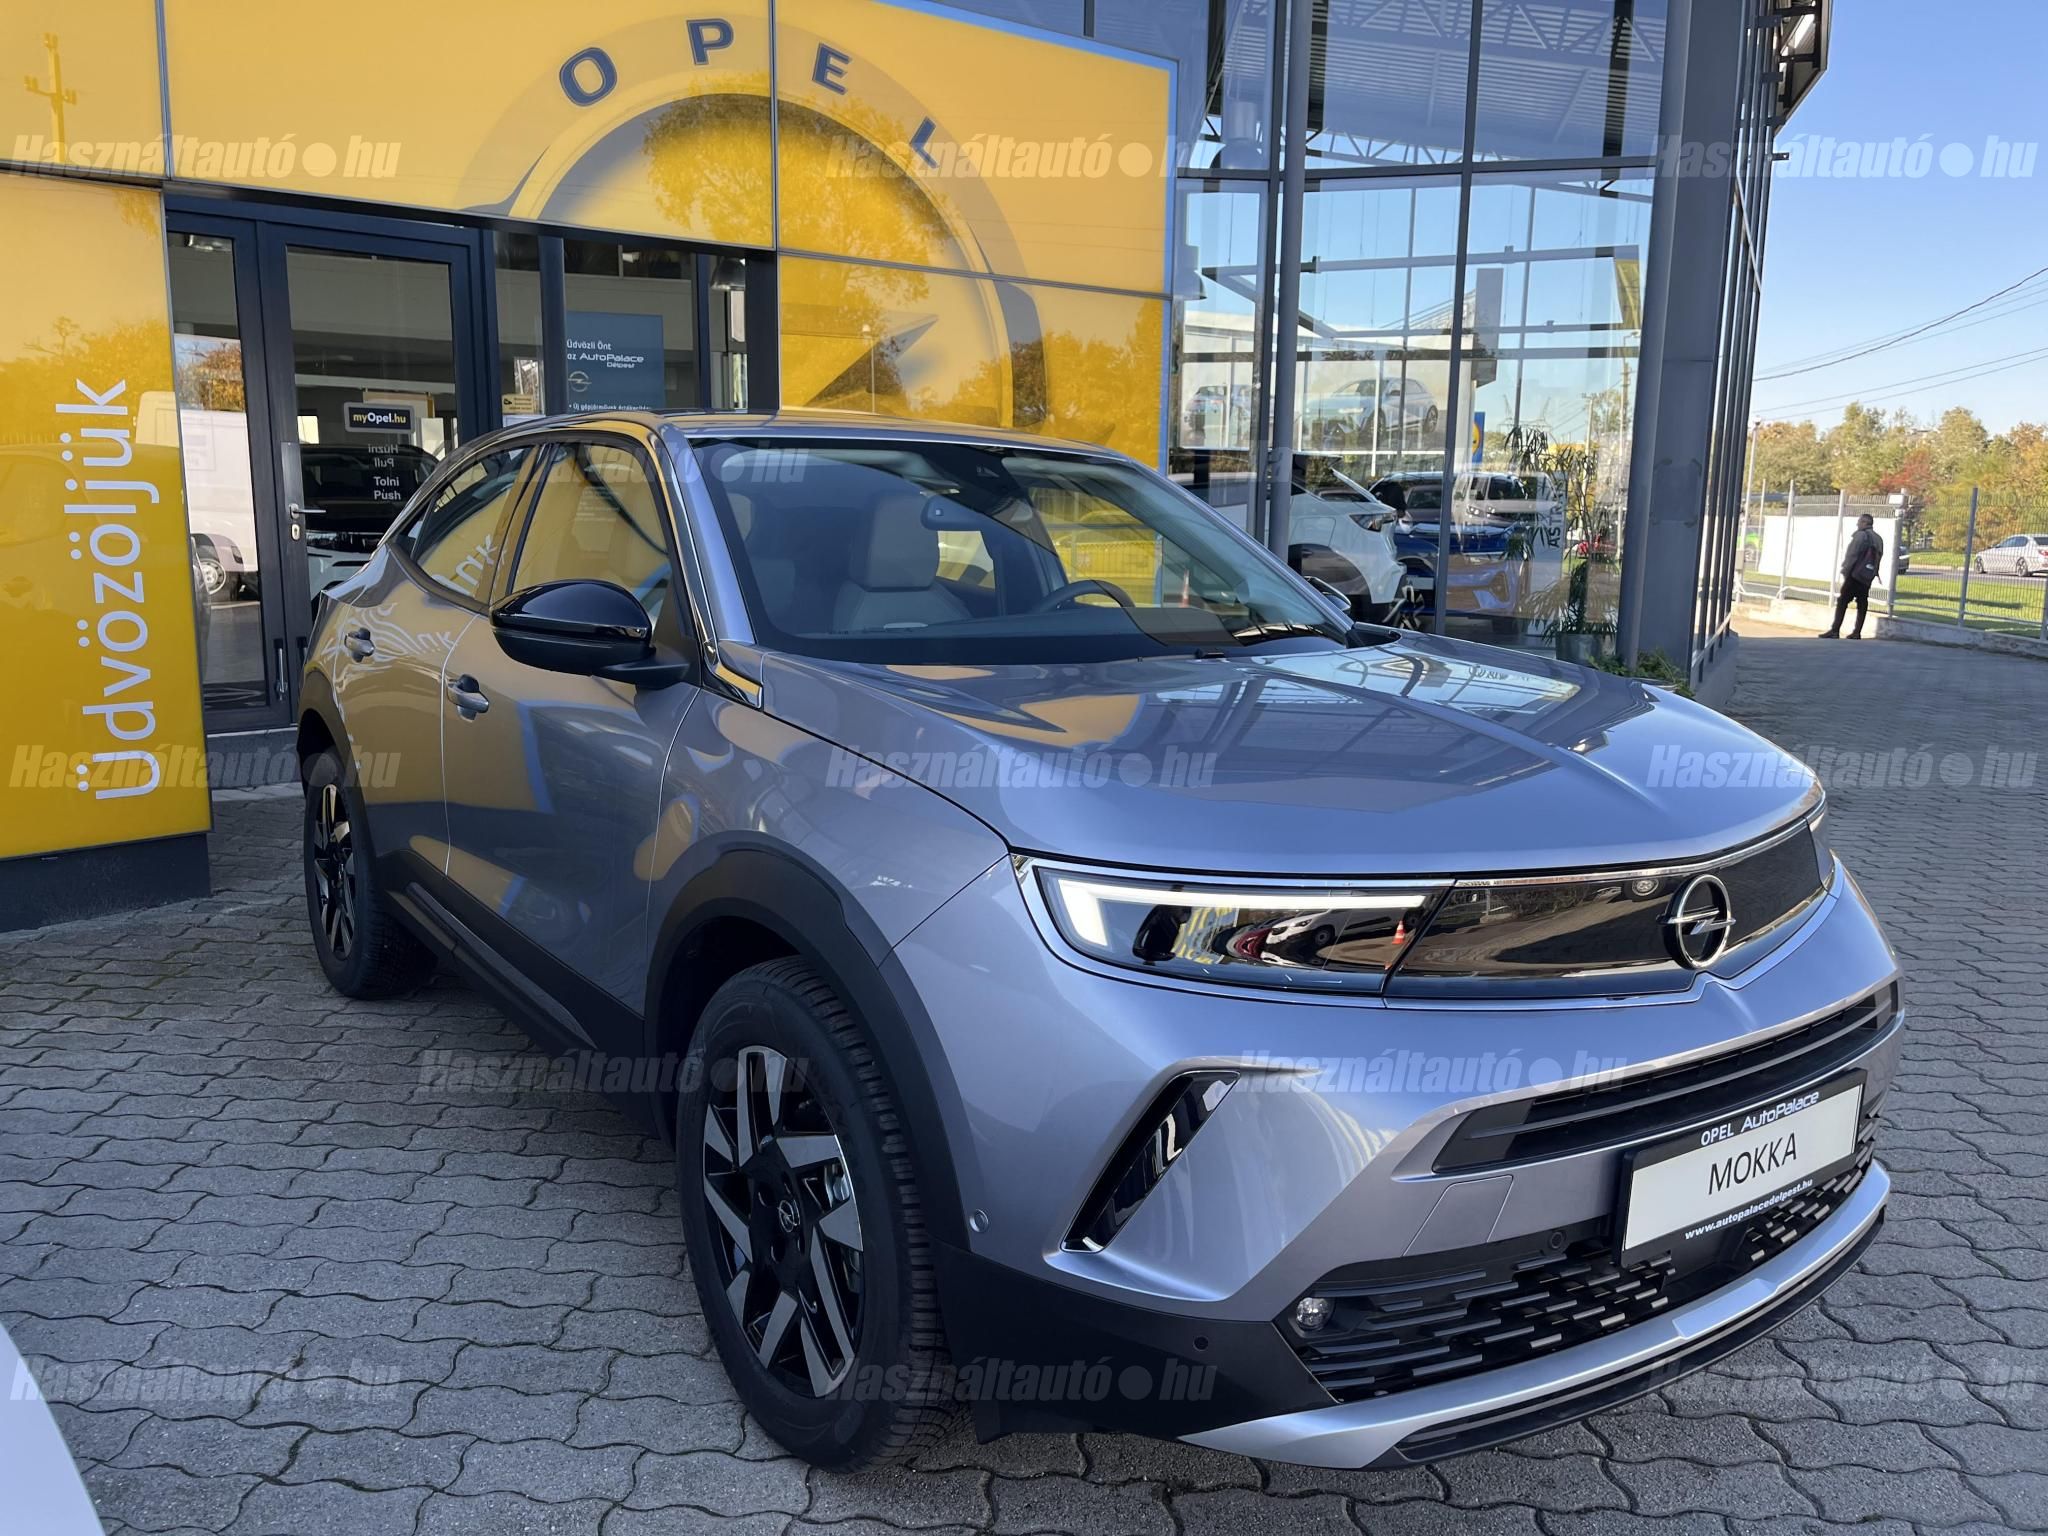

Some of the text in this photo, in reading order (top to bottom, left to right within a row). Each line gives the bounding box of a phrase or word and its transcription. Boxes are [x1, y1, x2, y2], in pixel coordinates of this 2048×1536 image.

[558, 18, 940, 169] OPEL
[579, 352, 645, 363] AutoPalace
[353, 412, 407, 425] myOpel.hu
[373, 476, 400, 487] Tolni
[373, 490, 401, 500] Push
[55, 378, 160, 800] Üdvözöljük
[1701, 1091, 1819, 1146] OPEL AutoPalace
[1708, 1132, 1797, 1195] MOKKA
[1684, 1178, 1813, 1241] www.autopalacedelpest.hu
